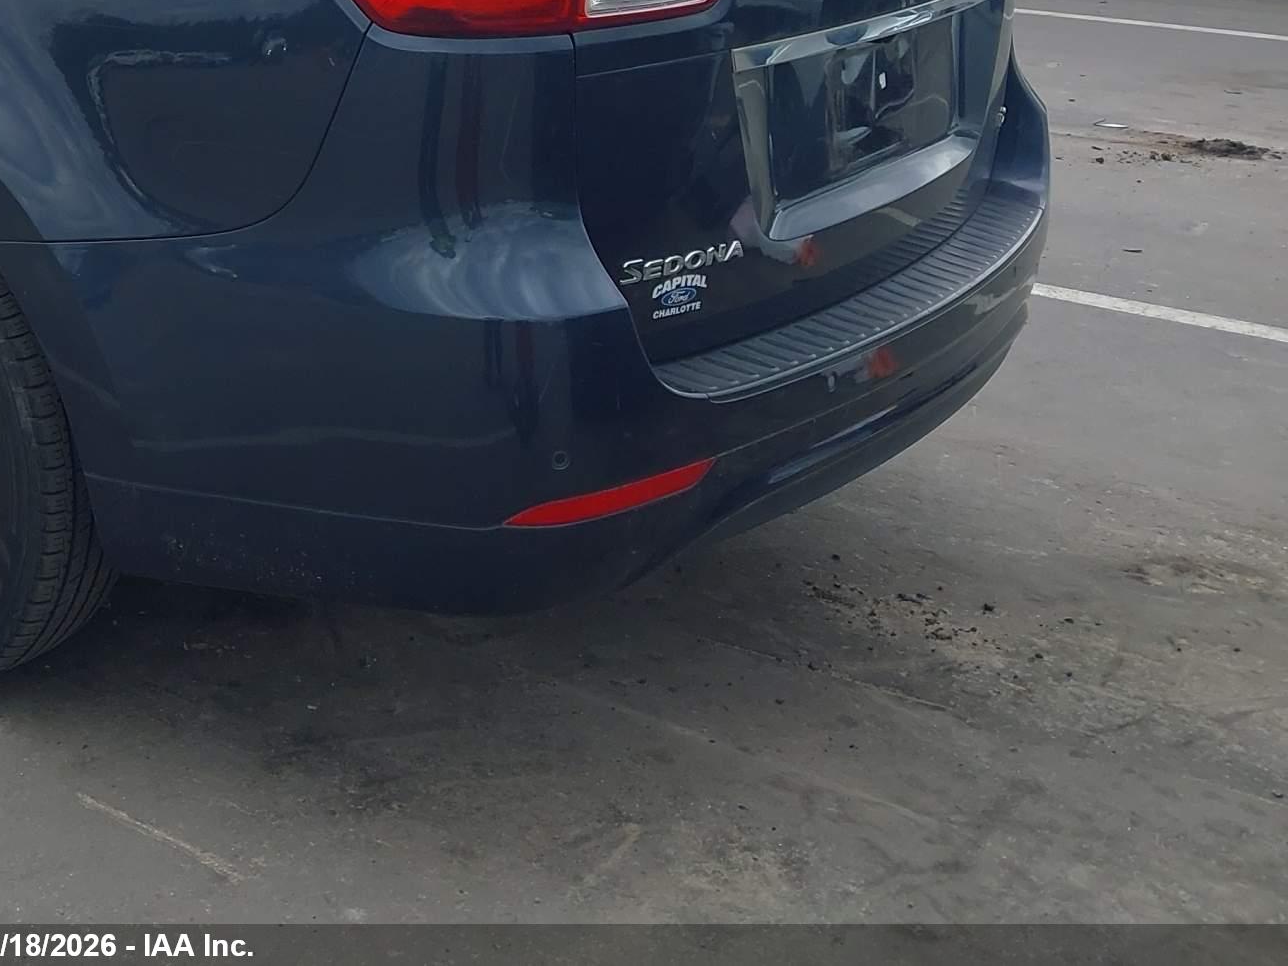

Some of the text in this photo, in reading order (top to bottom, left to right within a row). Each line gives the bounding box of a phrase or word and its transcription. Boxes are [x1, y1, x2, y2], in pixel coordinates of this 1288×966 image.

[619, 240, 744, 286] SEDONA
[652, 274, 708, 299] CAPITAL
[667, 290, 691, 304] Ford
[652, 301, 702, 320] CHARLOTTE
